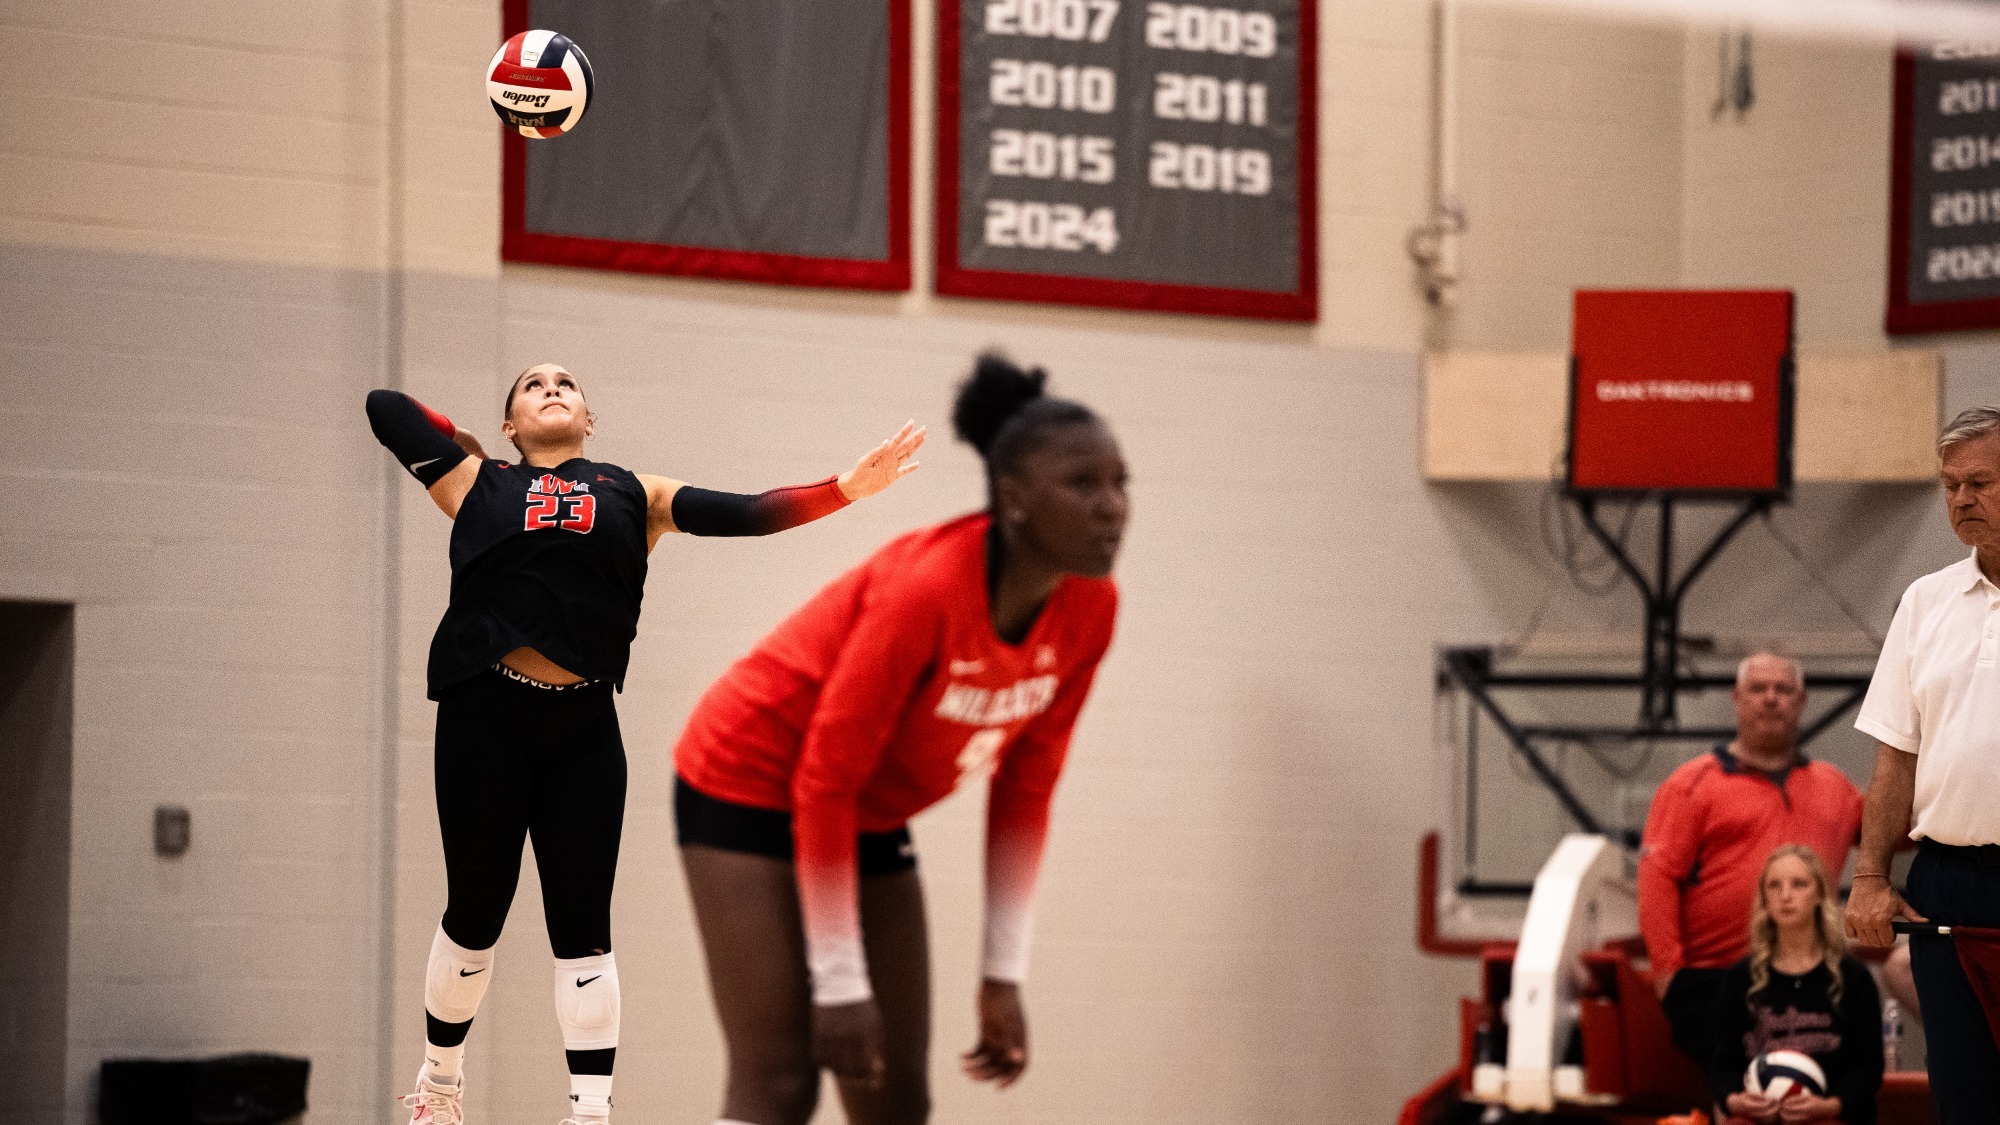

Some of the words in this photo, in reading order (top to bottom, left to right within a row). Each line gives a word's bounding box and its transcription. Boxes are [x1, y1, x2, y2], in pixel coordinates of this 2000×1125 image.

[985, 0, 1119, 41] 2007
[1146, 2, 1277, 58] 2009
[502, 90, 550, 107] Baden
[990, 58, 1116, 113] 2010
[1155, 72, 1267, 126] 2011
[990, 129, 1116, 184] 2015
[1150, 141, 1271, 195] 2019
[985, 199, 1120, 253] 2024
[1596, 379, 1754, 402] DAKTRONICS
[524, 493, 596, 535] 23
